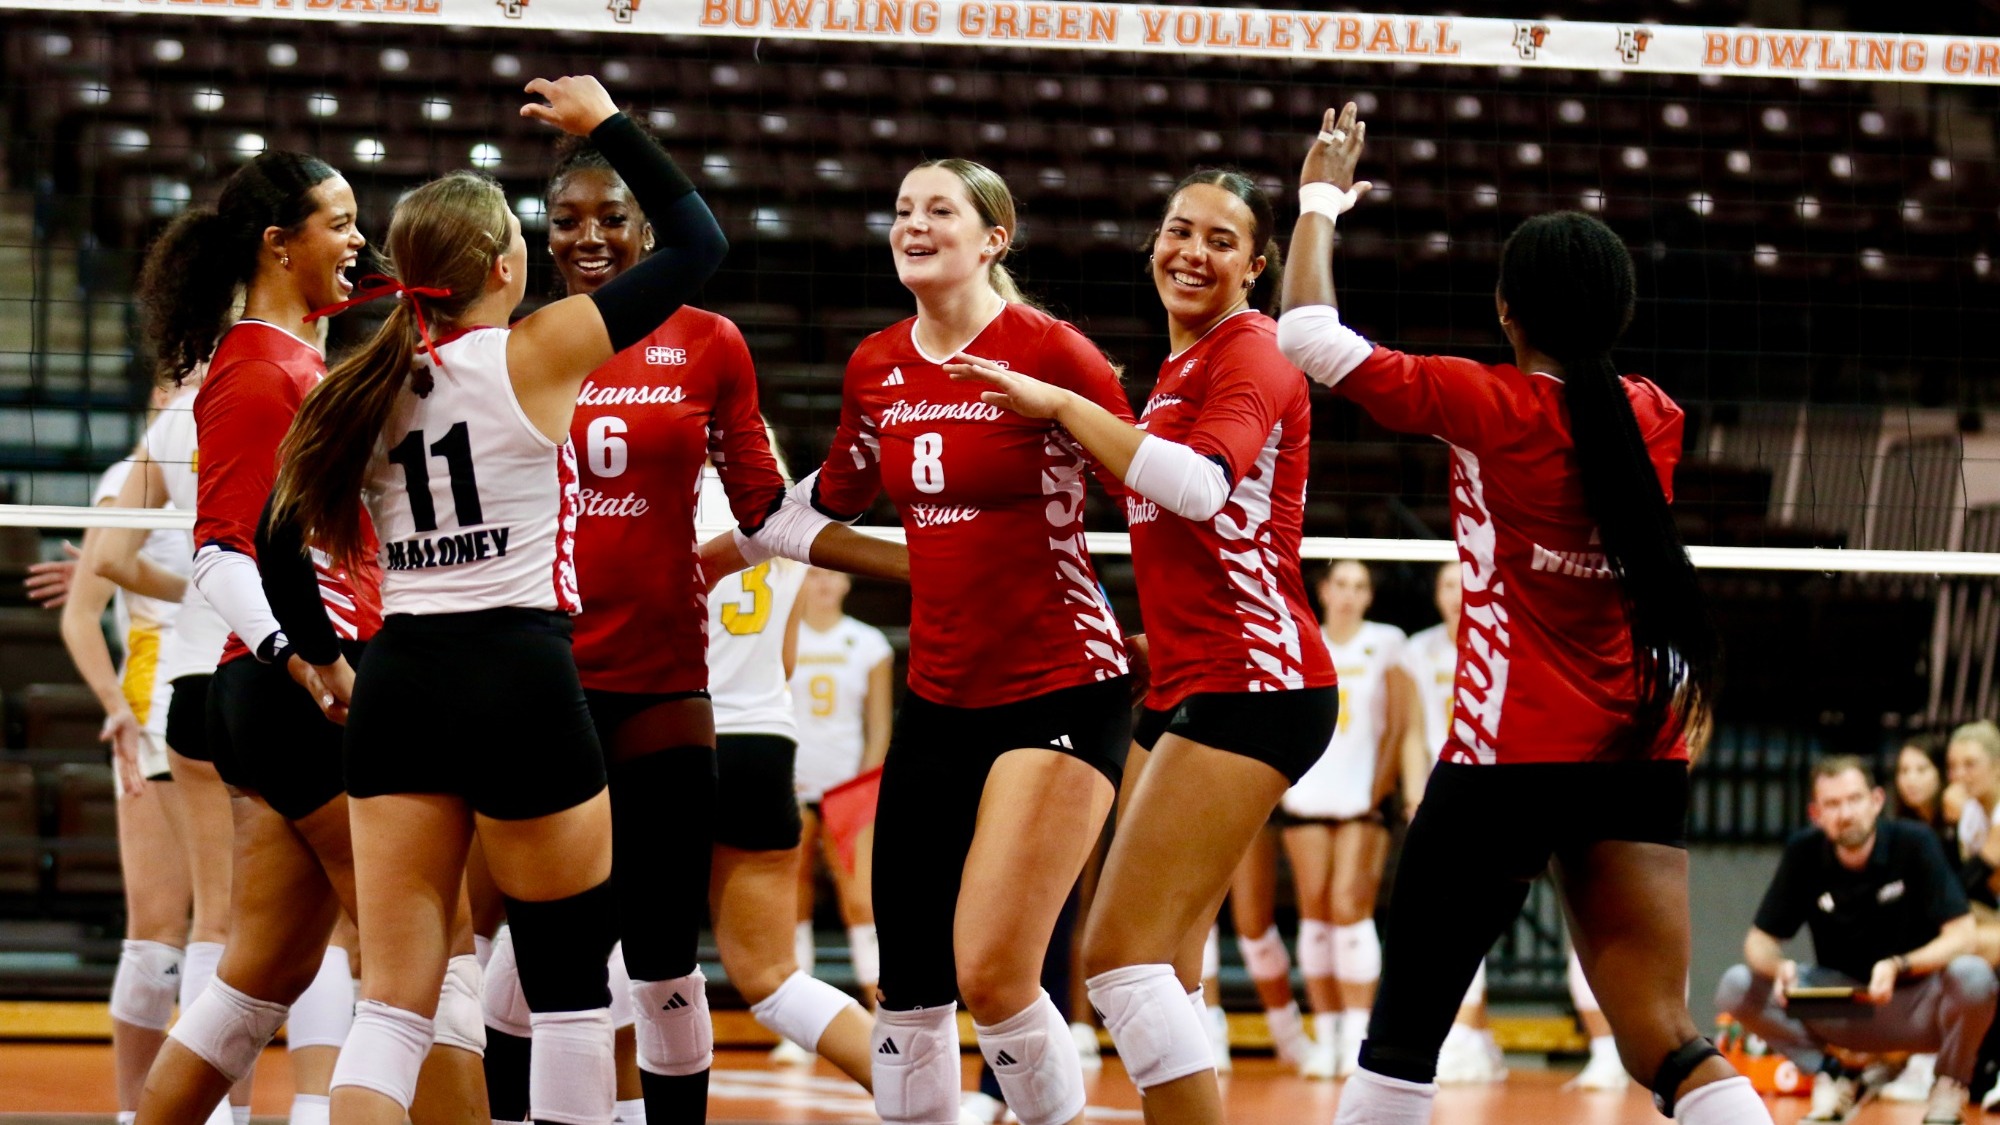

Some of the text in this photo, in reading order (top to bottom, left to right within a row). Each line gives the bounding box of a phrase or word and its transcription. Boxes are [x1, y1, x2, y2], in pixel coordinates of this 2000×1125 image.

[700, 0, 1461, 57] BOWLING GREEN VOLLEYBALL
[1702, 31, 1928, 75] BOWLING
[646, 346, 686, 365] SBC
[576, 381, 686, 406] kansas
[881, 398, 1004, 428] Arkansas
[587, 416, 628, 478] 6
[911, 432, 945, 494] 8
[388, 421, 483, 532] 11
[577, 488, 649, 517] State
[910, 502, 980, 528] State
[386, 527, 509, 570] MALONEY
[721, 559, 773, 635] 3
[809, 674, 836, 719] 9
